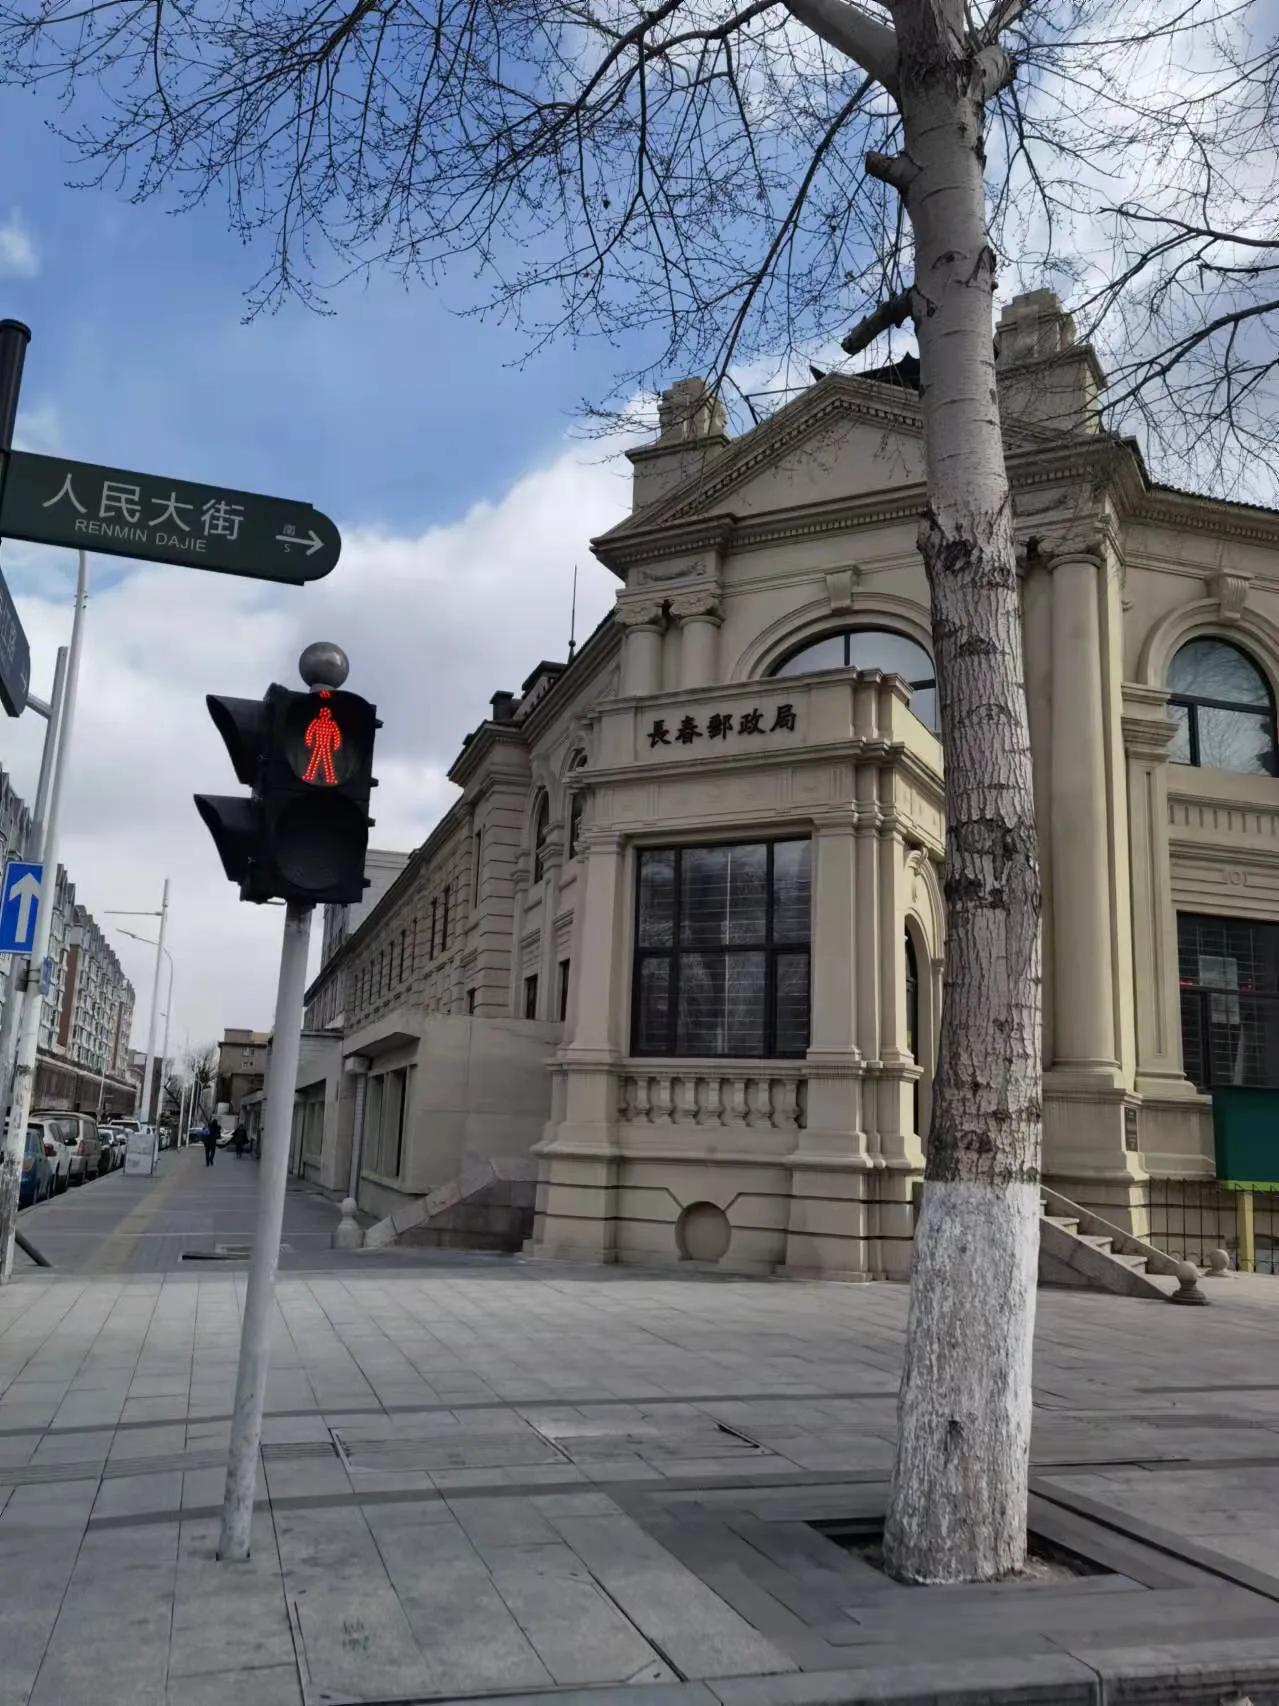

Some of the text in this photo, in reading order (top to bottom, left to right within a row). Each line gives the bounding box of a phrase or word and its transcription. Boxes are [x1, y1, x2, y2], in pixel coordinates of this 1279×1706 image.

[43, 473, 244, 540] 人民大街
[75, 519, 207, 552] RENMIN DAJIE
[283, 543, 291, 553] S
